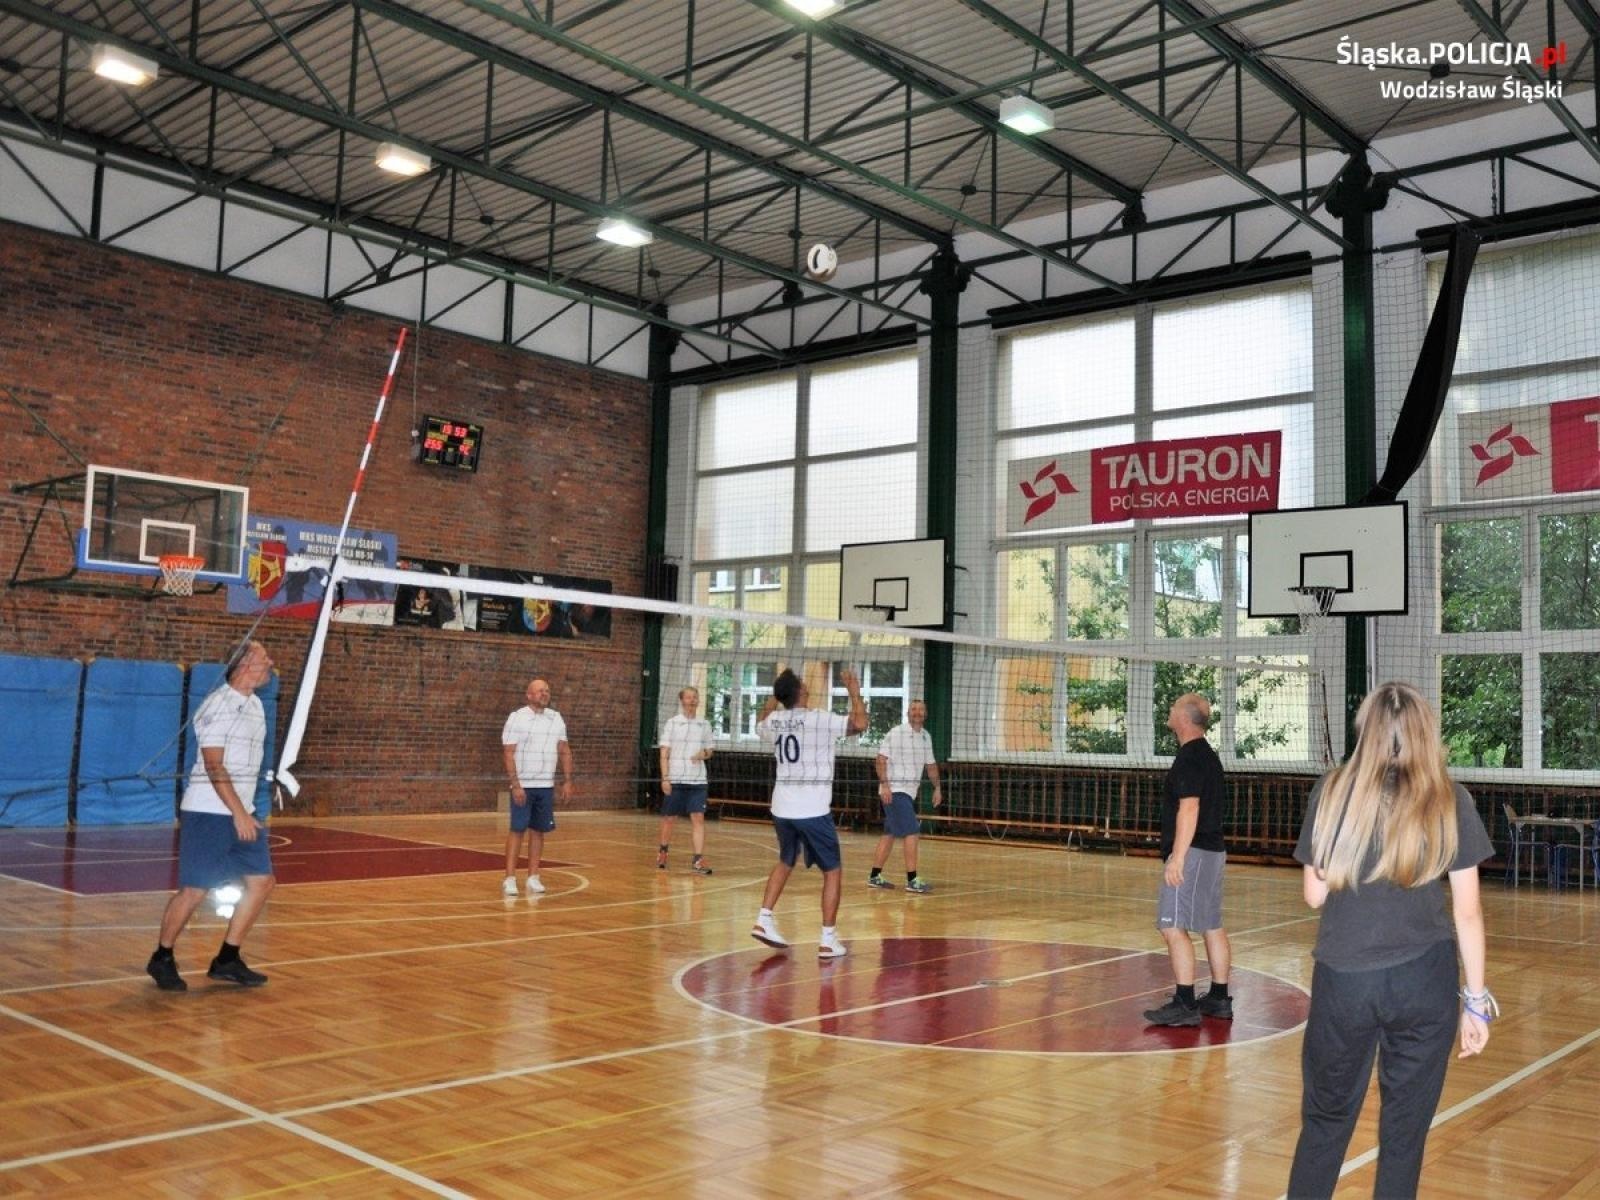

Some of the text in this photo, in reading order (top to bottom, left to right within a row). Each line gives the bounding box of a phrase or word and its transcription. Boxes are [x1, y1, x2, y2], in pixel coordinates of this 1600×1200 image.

[1101, 442, 1273, 490] TAURON
[1110, 484, 1270, 512] POLSKA ENERGIA
[774, 734, 800, 764] 10
